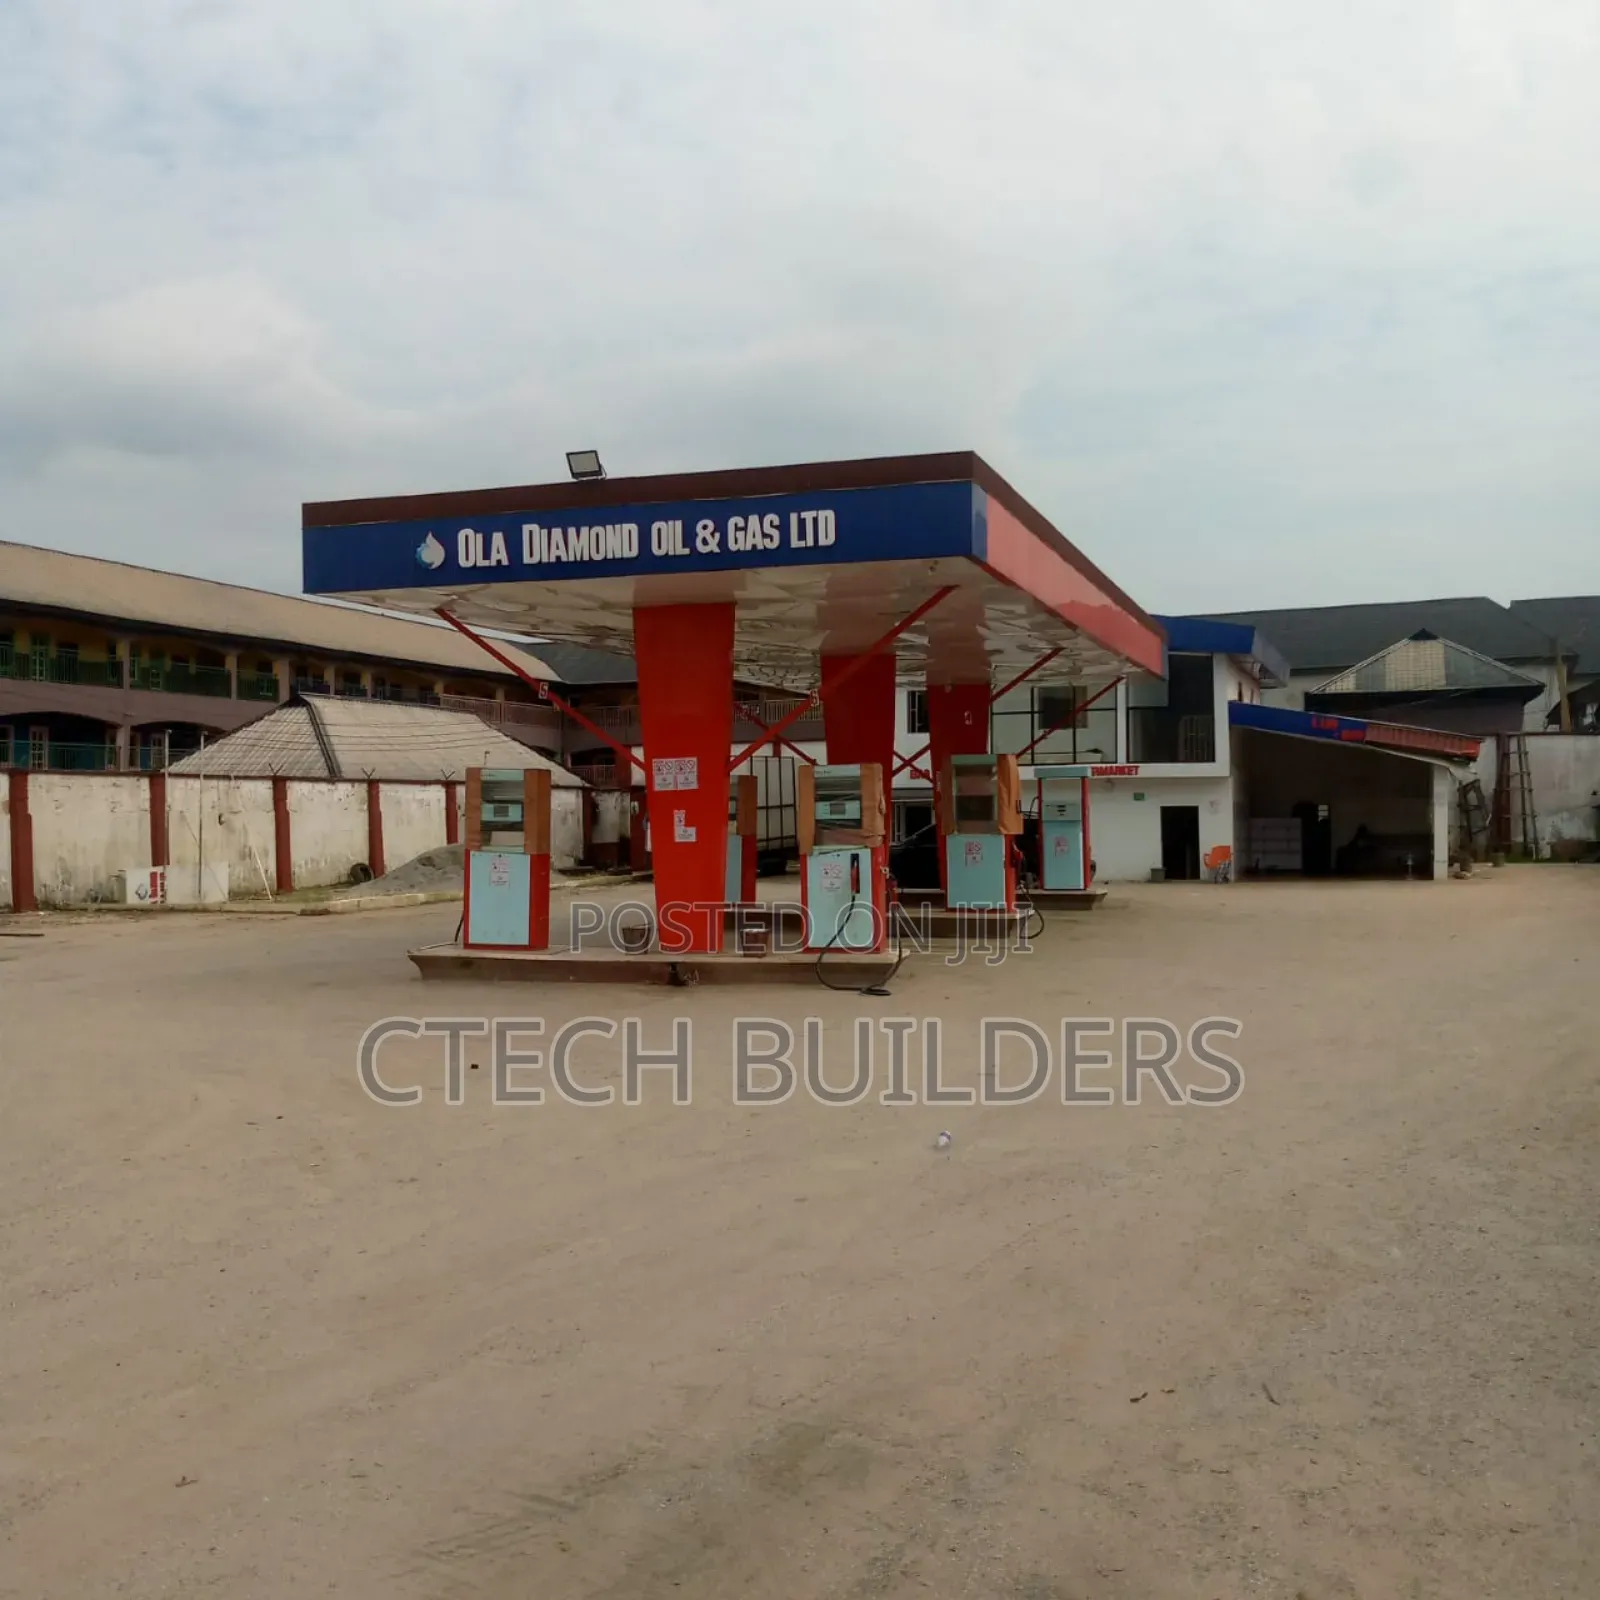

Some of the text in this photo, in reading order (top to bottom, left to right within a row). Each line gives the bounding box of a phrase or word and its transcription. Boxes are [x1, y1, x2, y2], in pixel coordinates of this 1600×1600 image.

[457, 509, 836, 568] OLA DIAMOND OIL & GAS LTD
